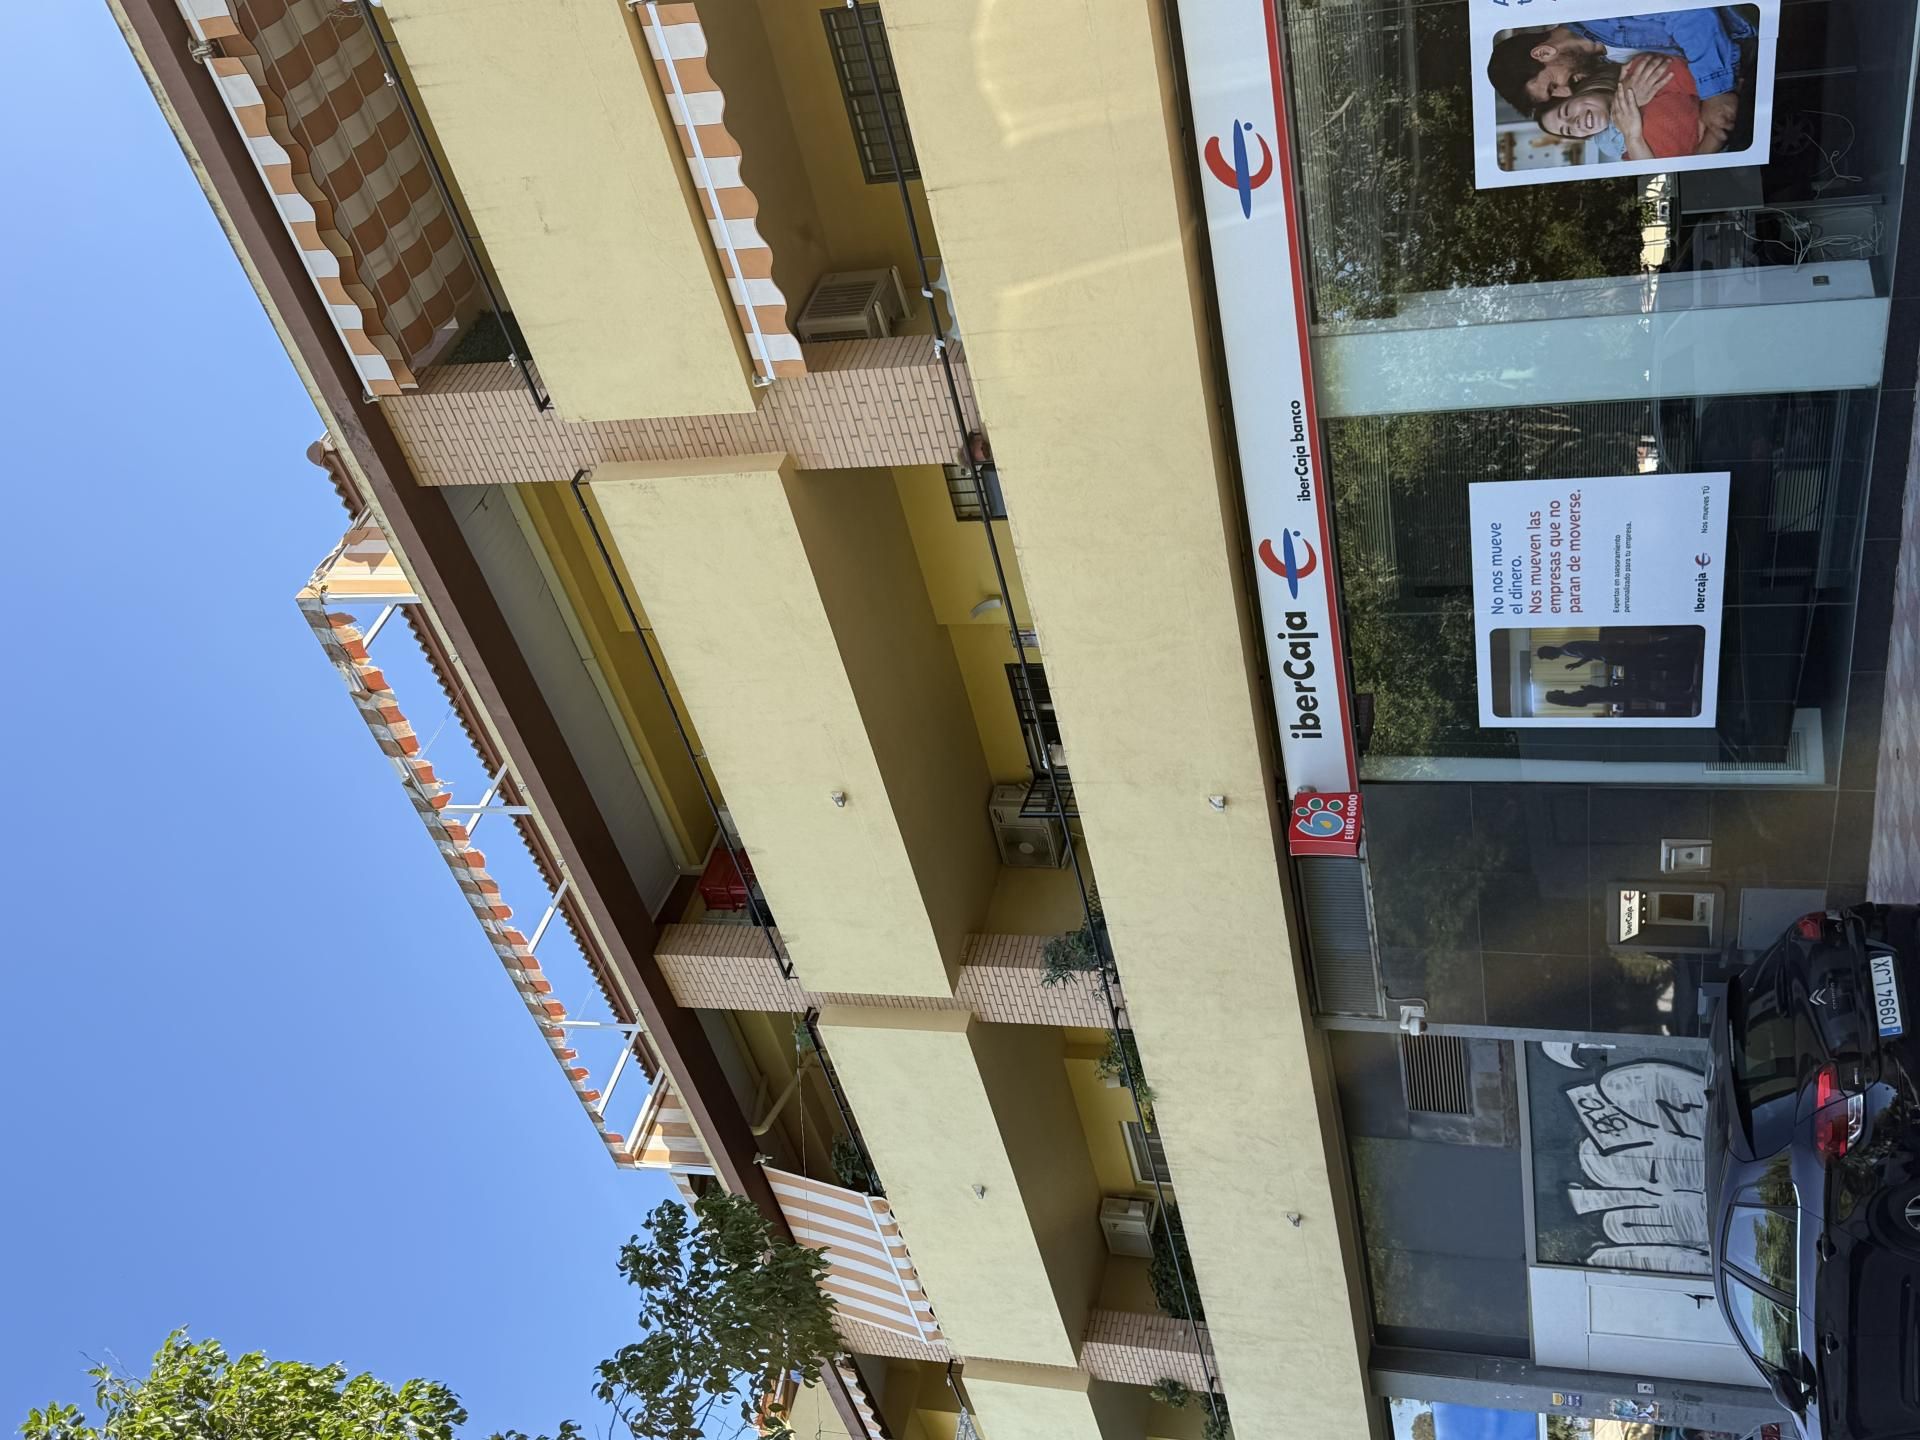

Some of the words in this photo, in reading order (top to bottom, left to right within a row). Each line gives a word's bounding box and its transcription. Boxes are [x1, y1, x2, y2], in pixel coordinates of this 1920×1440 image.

[1289, 400, 1305, 442] banco
[1292, 445, 1312, 502] iberCaja
[1526, 510, 1541, 530] las
[1549, 500, 1561, 518] no
[1568, 489, 1581, 551] moverse.
[1702, 495, 1710, 520] mueves
[1549, 522, 1564, 547] que
[1625, 521, 1633, 549] empresa.
[1700, 521, 1709, 534] Nos
[1490, 522, 1503, 566] mueve
[1613, 534, 1621, 578] asesoramiento
[1529, 533, 1542, 586] mueven
[1566, 555, 1581, 572] de
[1624, 558, 1632, 572] para
[1491, 570, 1504, 593] nos
[1508, 555, 1523, 600] dinero.
[1549, 551, 1565, 614] empresas
[1614, 578, 1620, 586] en
[1528, 589, 1543, 614] Nos
[1568, 576, 1584, 613] paran
[1612, 587, 1621, 613] Expertos
[1623, 572, 1631, 613] personalizado
[1694, 572, 1709, 613] Ibercaja
[1490, 597, 1505, 615] No
[1508, 603, 1523, 615] el
[1277, 611, 1322, 739] iberCaja
[1346, 794, 1358, 817] 6000
[1344, 817, 1356, 840] EURO
[1872, 959, 1892, 985] LJX
[1877, 989, 1898, 1025] 0994
